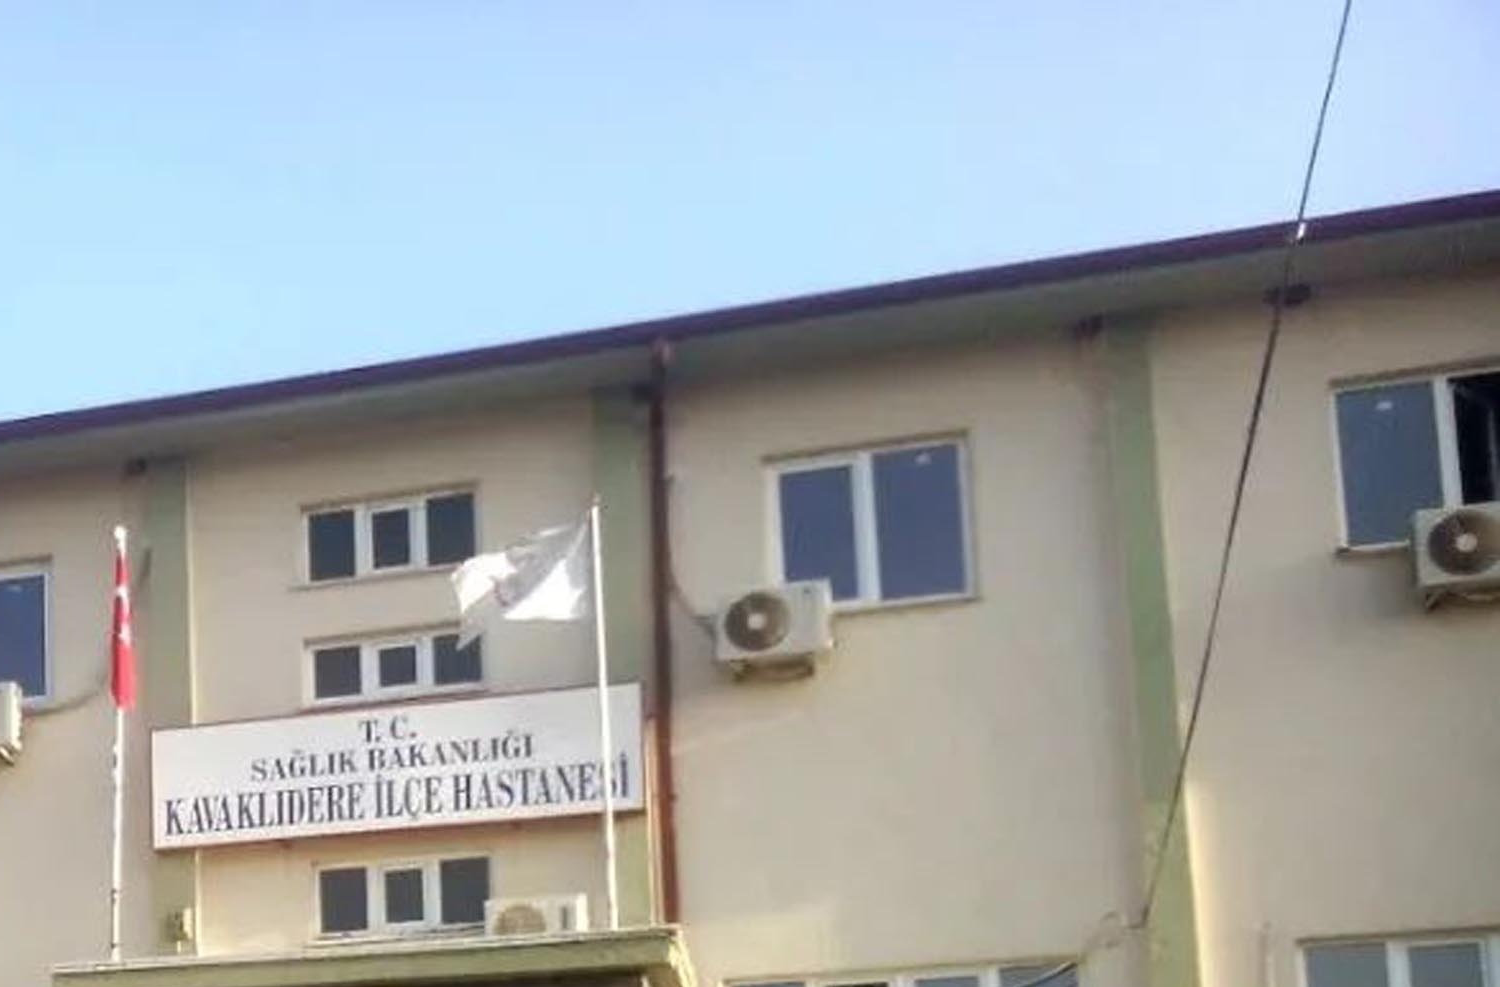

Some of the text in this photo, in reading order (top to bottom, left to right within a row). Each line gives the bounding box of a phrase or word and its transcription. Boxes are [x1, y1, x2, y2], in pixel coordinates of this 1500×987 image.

[250, 729, 534, 782] SAĞLIK BAKANLIĞI
[164, 752, 630, 836] KAVAKLIDERE İLÇE HASTANESİ
